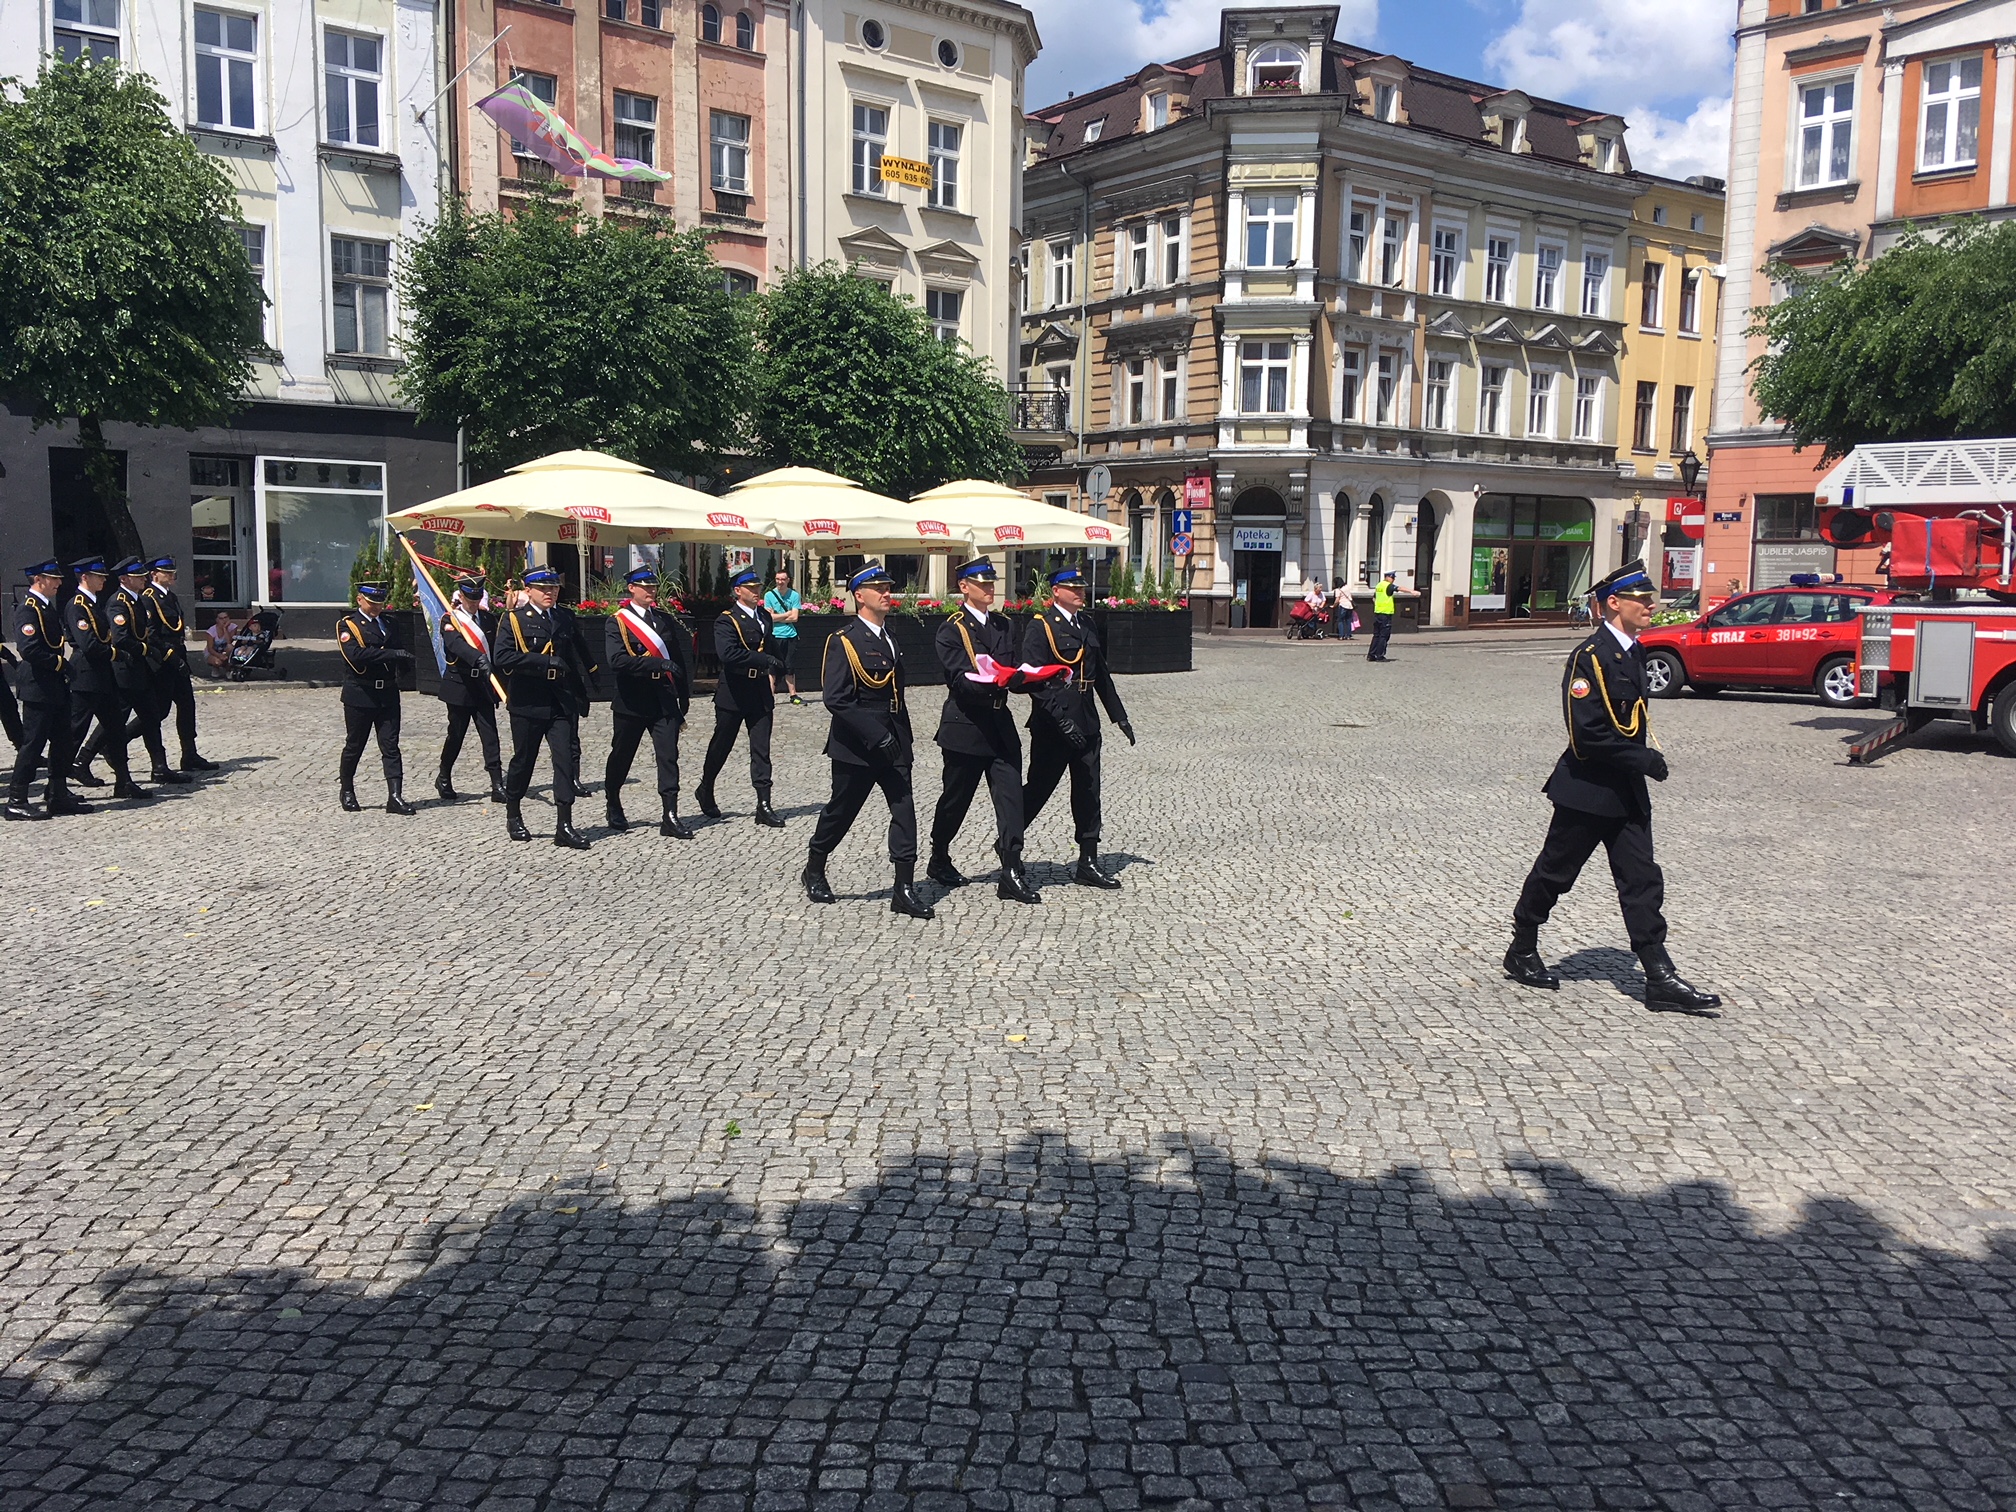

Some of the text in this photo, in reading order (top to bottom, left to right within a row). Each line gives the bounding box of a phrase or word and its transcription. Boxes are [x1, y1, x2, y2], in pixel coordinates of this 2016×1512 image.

[886, 170, 900, 179] 605
[904, 173, 918, 183] 635
[567, 506, 605, 518] ŻYWIEC
[710, 513, 743, 525] ŻYWIEC
[807, 520, 836, 530] ŻYWIEC
[920, 521, 946, 532] ŻYWIEC
[997, 526, 1020, 536] ŻYWIEC
[1087, 526, 1109, 537] ŻYWIEC
[1236, 530, 1270, 541] Apteka
[1566, 527, 1583, 535] BANK
[1758, 547, 1828, 556] JUBILER JASPIS
